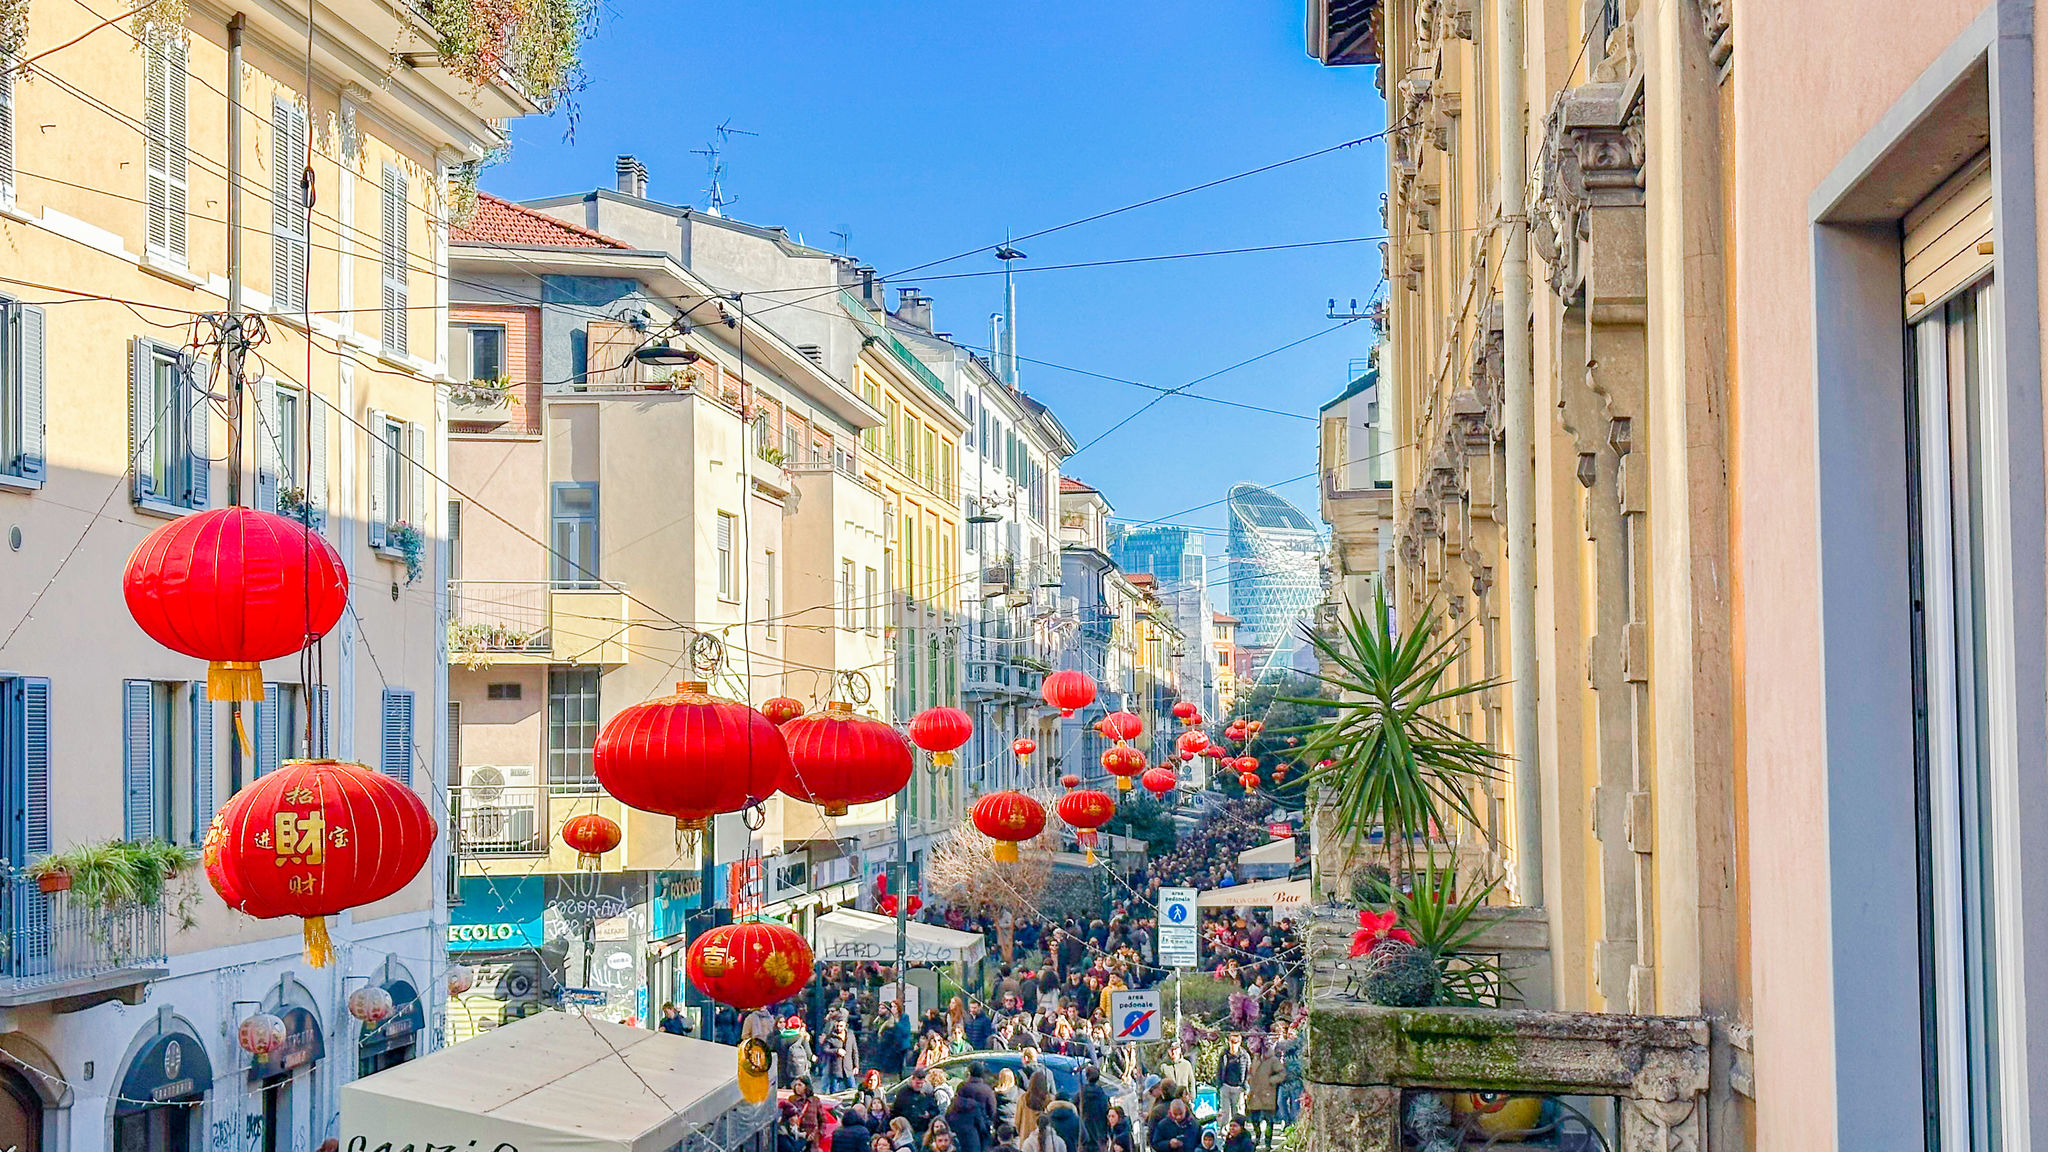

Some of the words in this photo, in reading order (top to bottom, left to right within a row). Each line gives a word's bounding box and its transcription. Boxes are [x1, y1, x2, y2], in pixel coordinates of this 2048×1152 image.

[285, 786, 314, 805] 招
[274, 810, 326, 867] 財
[328, 826, 349, 848] 宝
[289, 871, 317, 895] 财
[1273, 891, 1301, 903] Bar
[1119, 1001, 1153, 1009] pedonale
